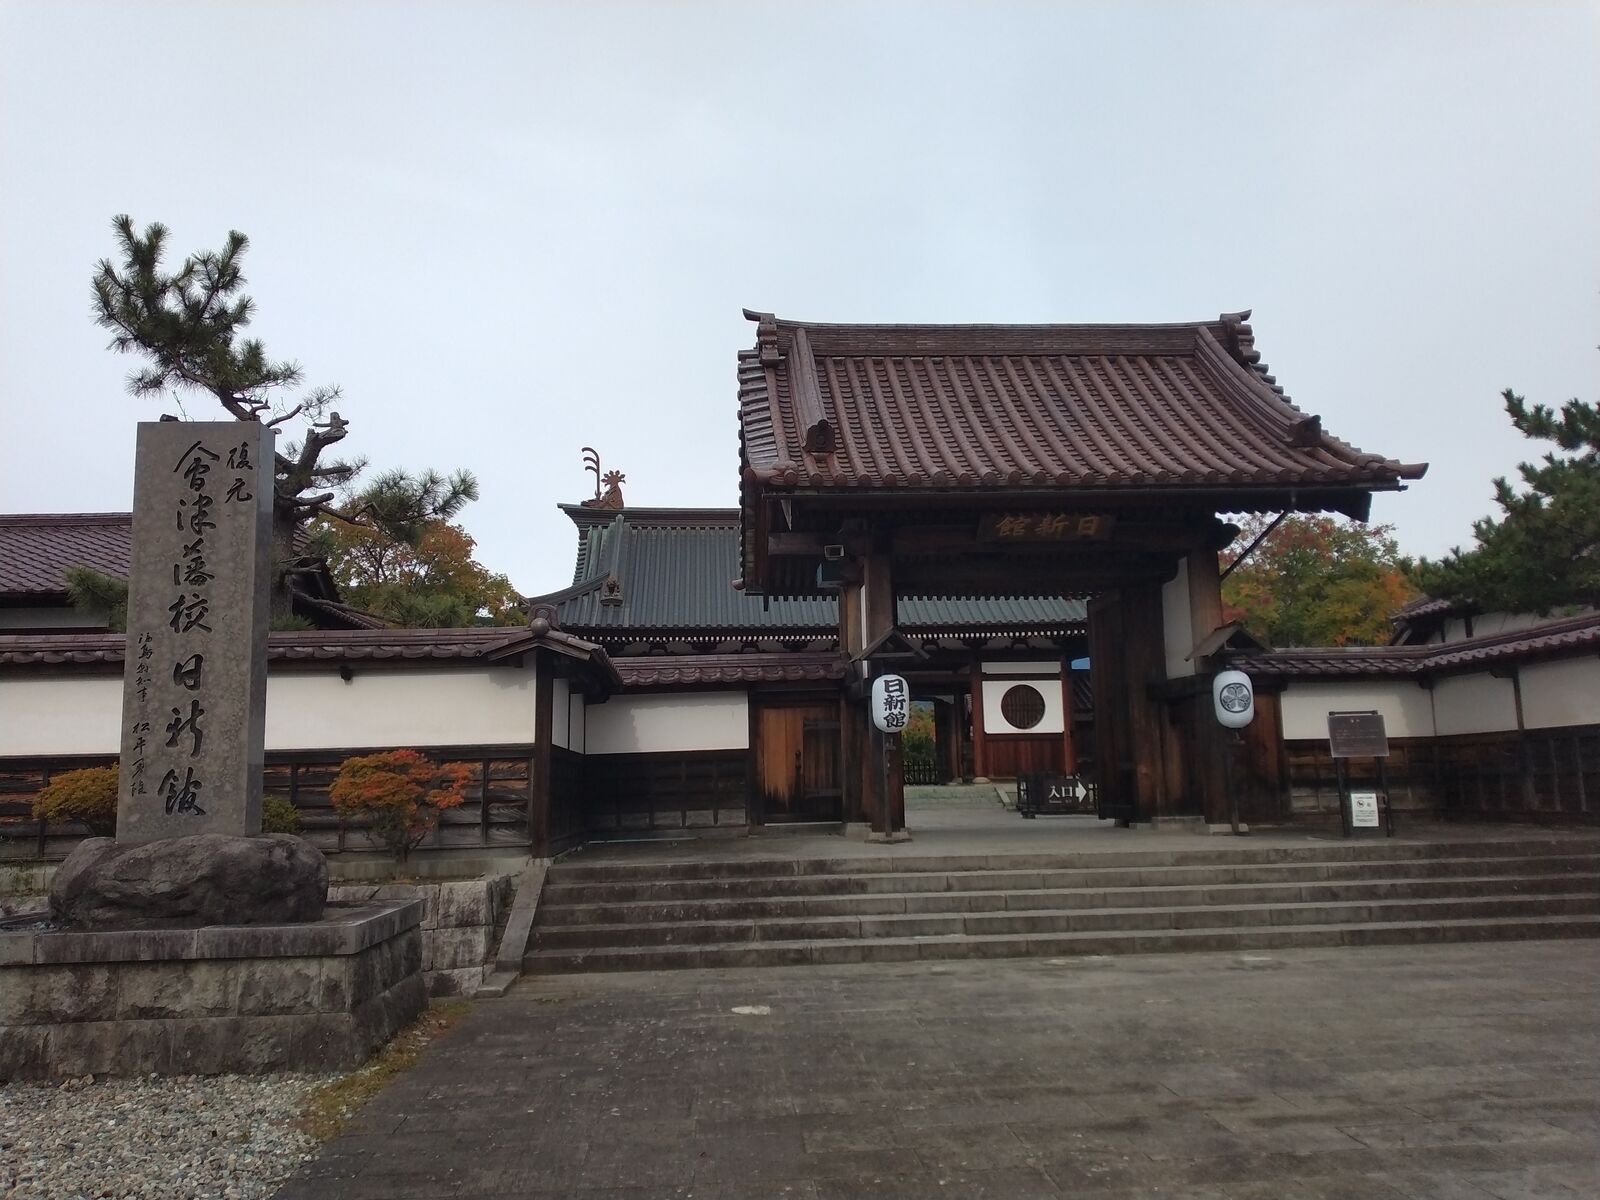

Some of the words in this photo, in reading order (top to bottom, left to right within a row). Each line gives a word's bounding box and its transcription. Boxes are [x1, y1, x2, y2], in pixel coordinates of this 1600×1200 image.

[883, 678, 906, 728] 日新館
[1048, 785, 1073, 798] 入口
